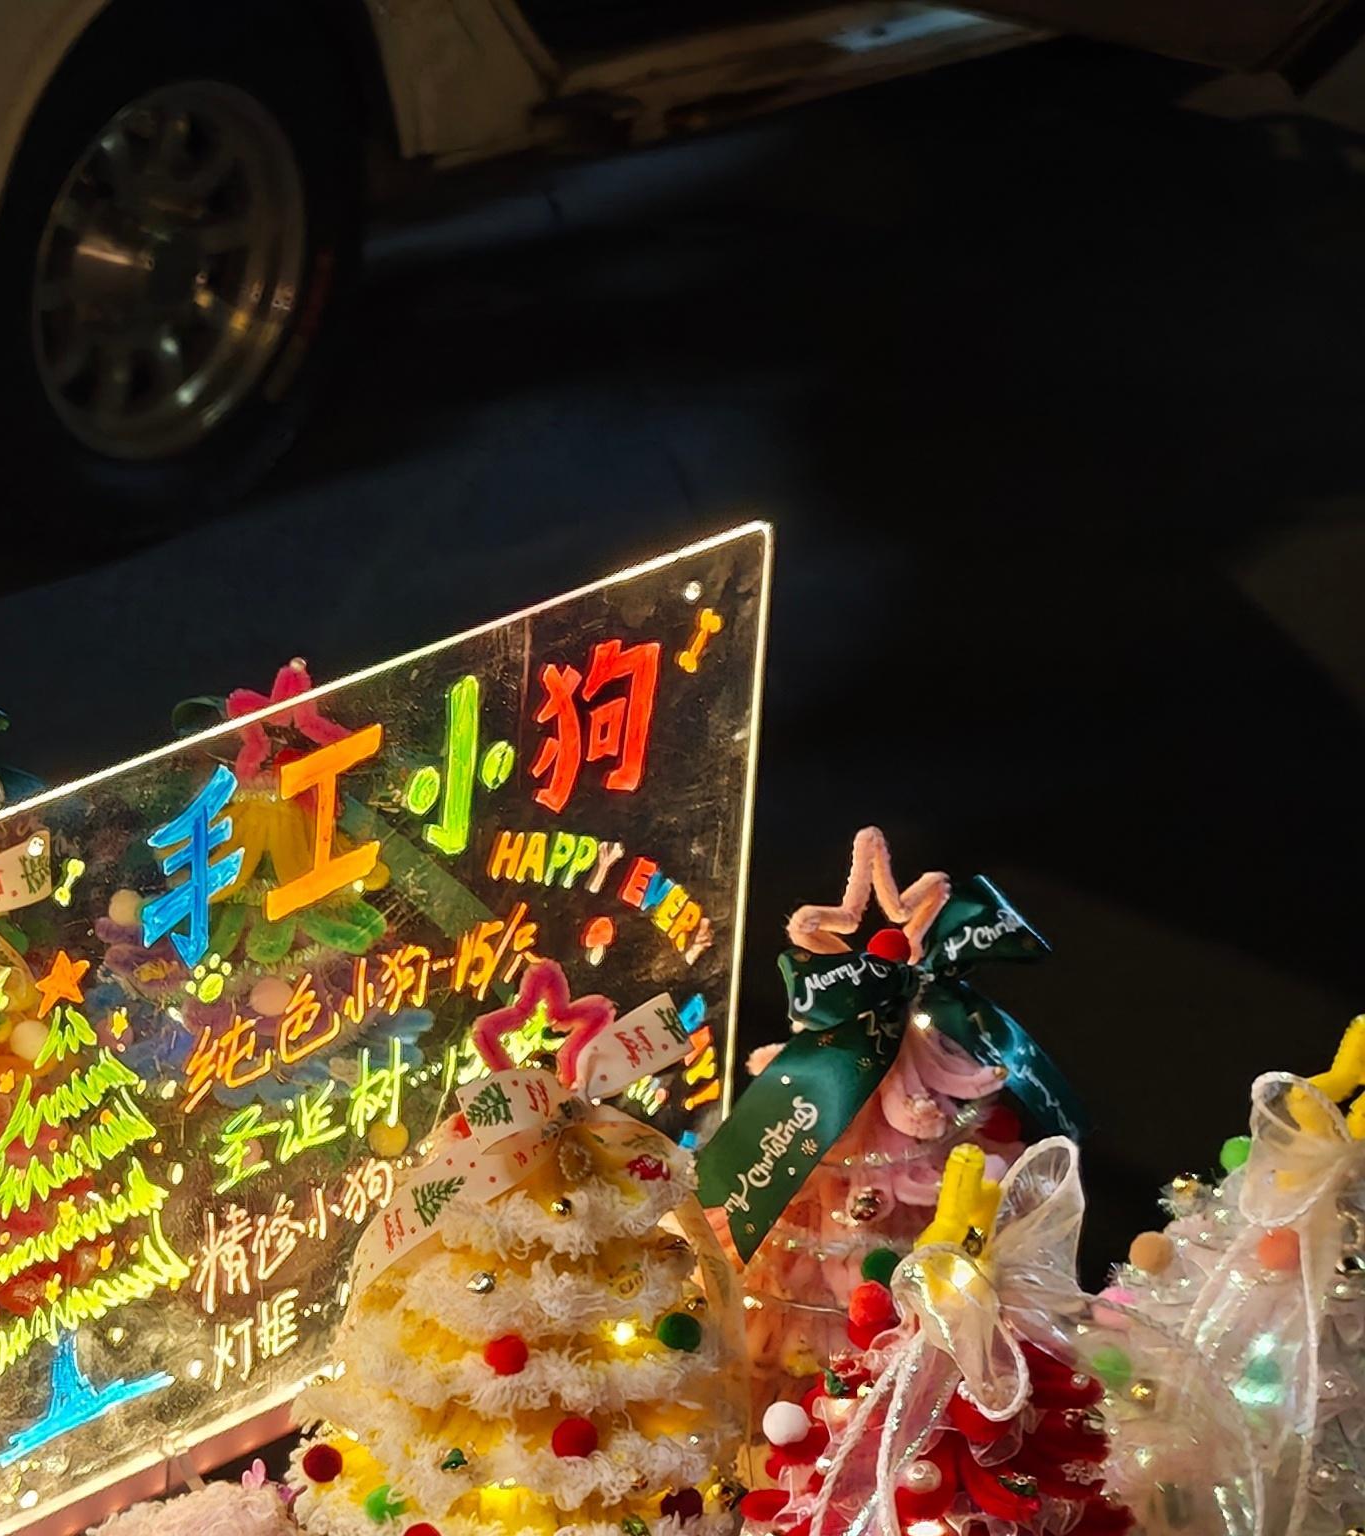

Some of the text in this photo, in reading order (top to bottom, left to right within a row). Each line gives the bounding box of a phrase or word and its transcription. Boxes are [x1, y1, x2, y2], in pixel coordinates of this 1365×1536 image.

[141, 637, 663, 969] 手工小狗
[487, 829, 625, 893] HAPPY
[618, 855, 714, 966] EVERY
[794, 955, 867, 1013] Merry
[746, 1095, 819, 1190] Christmas
